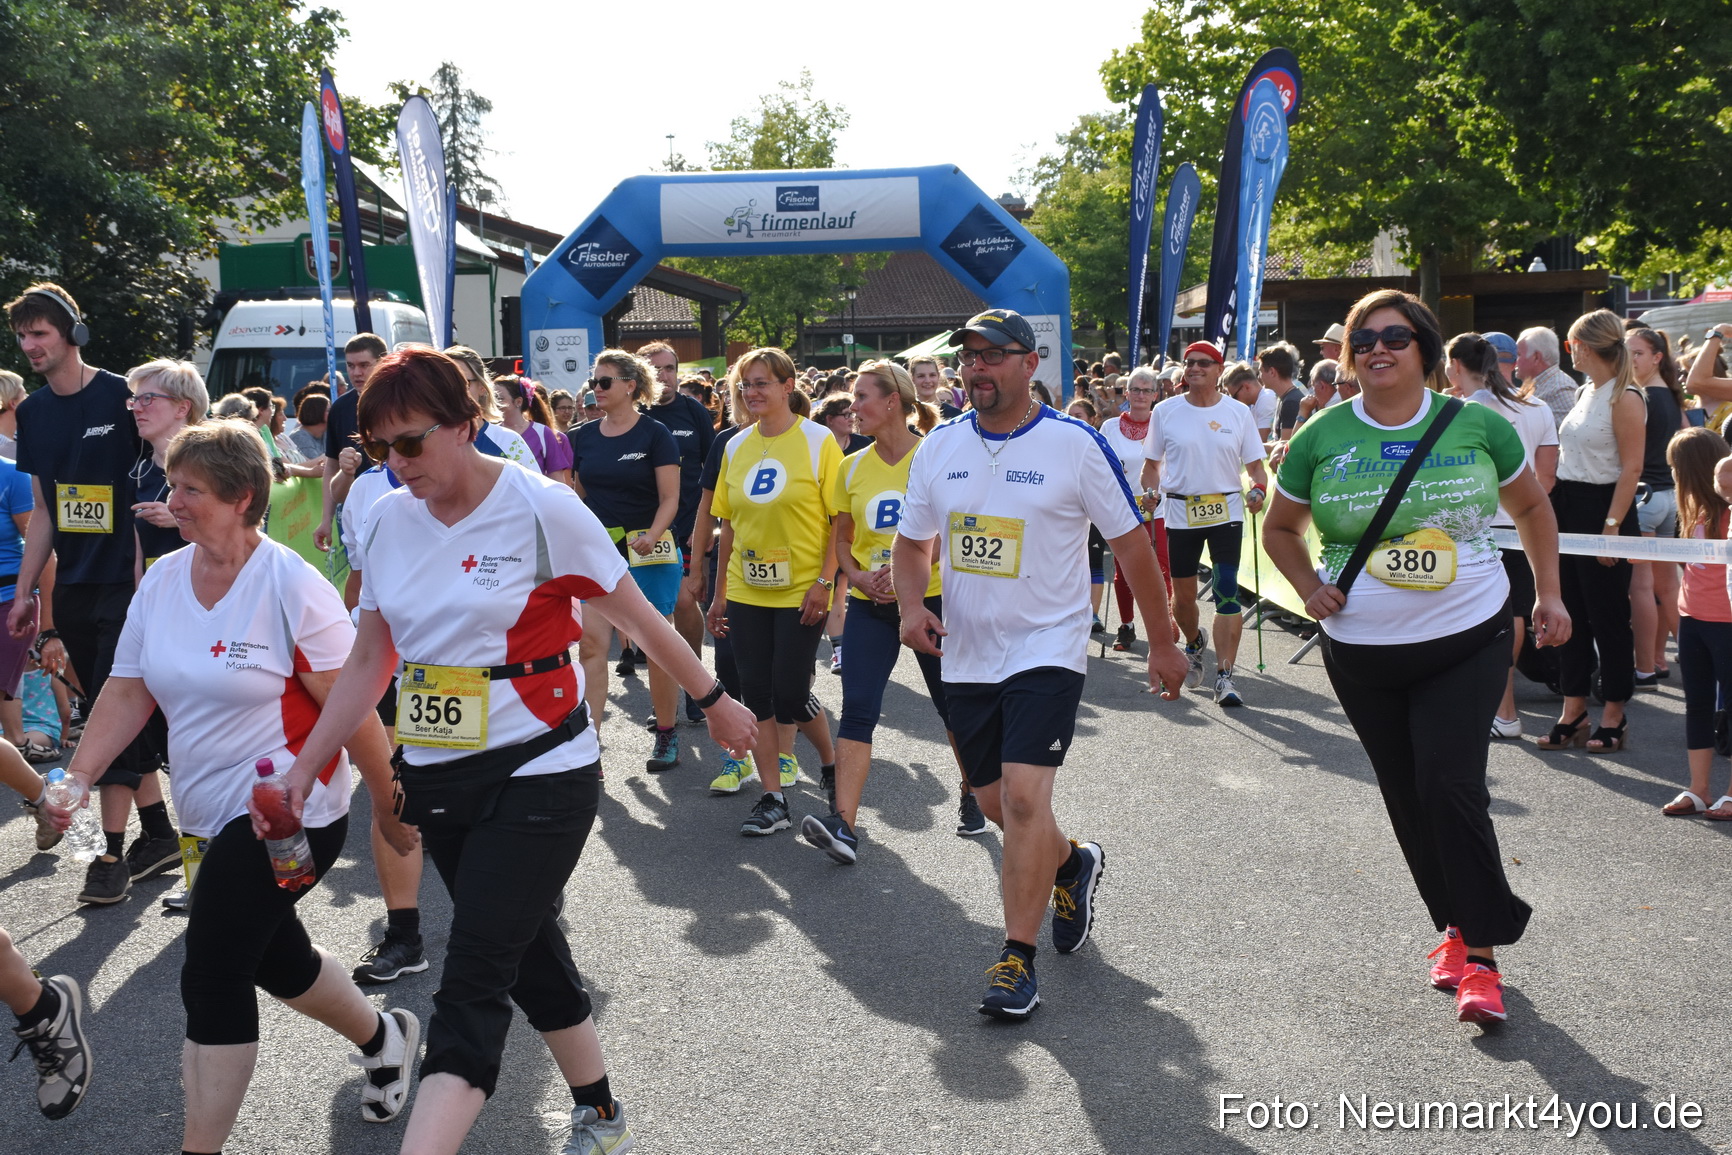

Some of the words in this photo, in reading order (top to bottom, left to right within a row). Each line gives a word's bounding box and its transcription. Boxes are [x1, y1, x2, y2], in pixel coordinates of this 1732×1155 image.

[785, 194, 817, 203] Fischer
[761, 210, 857, 230] firmenlauf
[578, 250, 630, 262] Fischer
[228, 325, 272, 335] abavent
[1356, 450, 1477, 474] firmnlauf
[750, 468, 777, 496] B
[947, 471, 969, 480] JAKO
[1006, 470, 1045, 485] GOSSNER
[1422, 483, 1486, 504] länger!
[64, 501, 104, 519] 1420
[875, 499, 901, 529] B
[1192, 503, 1223, 517] 1338
[961, 535, 1003, 560] 932
[482, 555, 522, 563] Bayerisches
[961, 556, 979, 564] Ennich
[1386, 549, 1437, 573] 380
[749, 562, 777, 578] 351
[1408, 572, 1433, 580] Claudia
[473, 576, 499, 590] Katja
[231, 641, 269, 650] Bayerisches
[226, 661, 262, 670] Marion
[409, 694, 462, 725] 356
[433, 725, 453, 735] Katja
